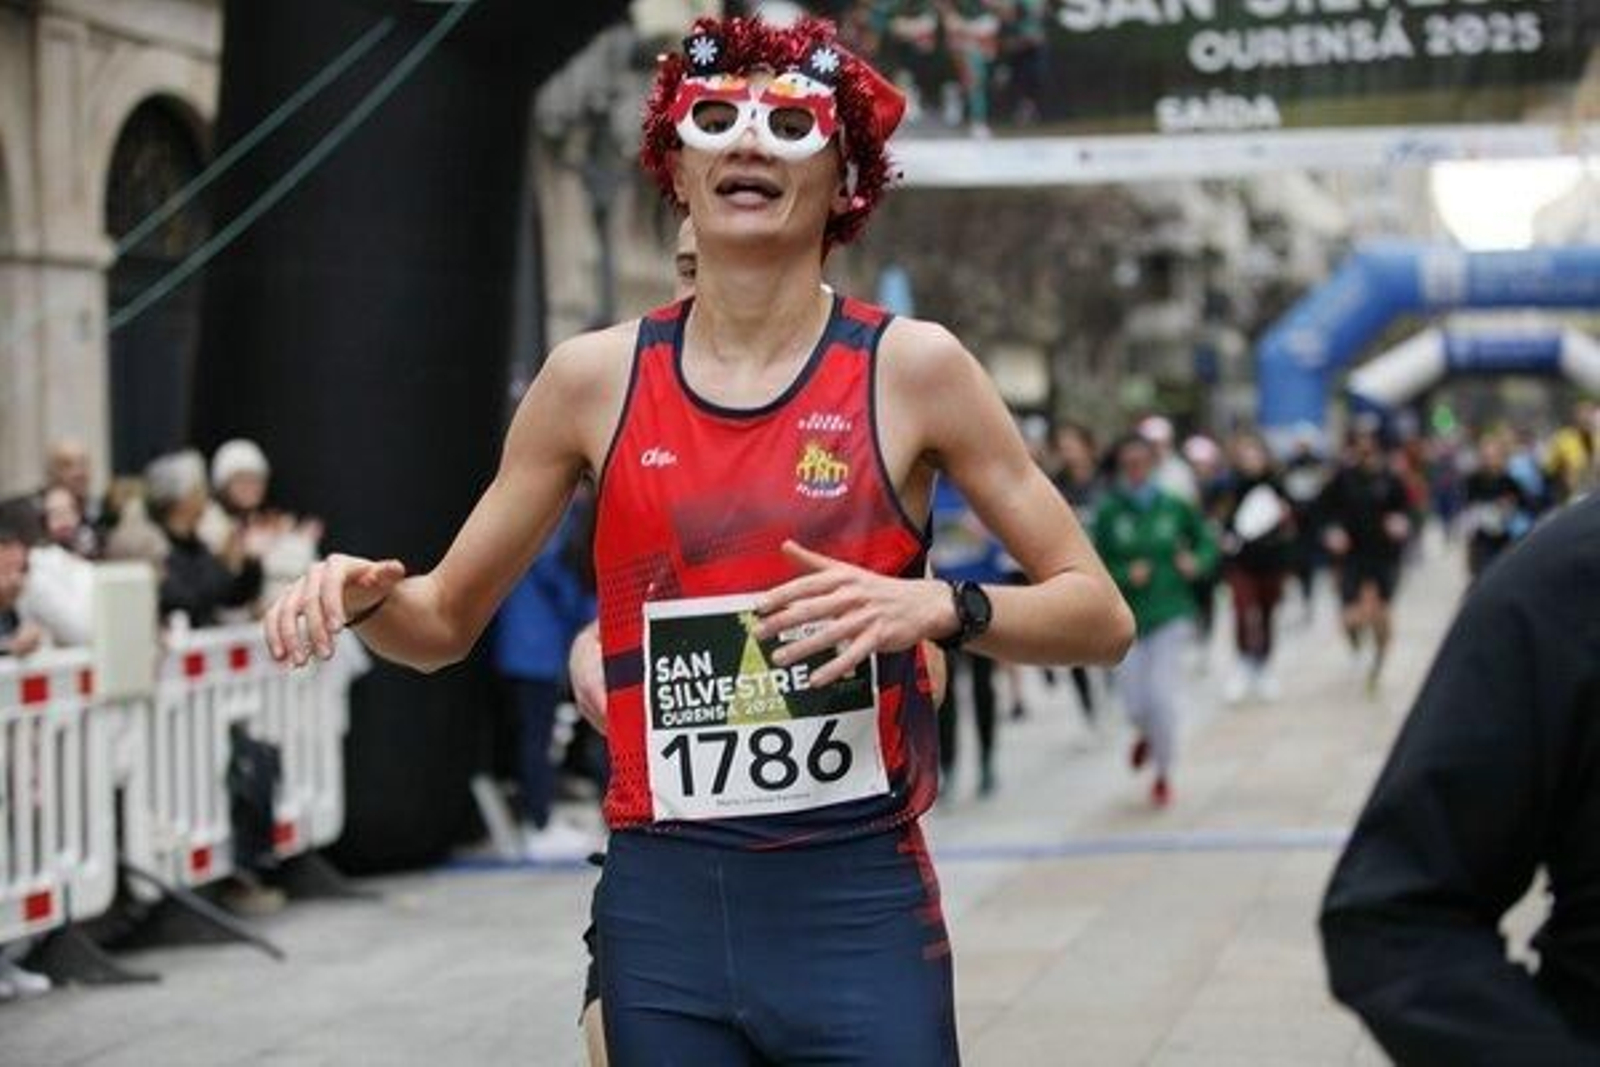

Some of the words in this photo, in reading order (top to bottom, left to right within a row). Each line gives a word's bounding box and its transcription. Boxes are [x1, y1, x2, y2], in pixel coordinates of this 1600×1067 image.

[1425, 11, 1543, 57] 2025
[656, 651, 713, 682] SAN
[657, 664, 811, 711] SILVESTRE
[661, 718, 853, 797] 1786
